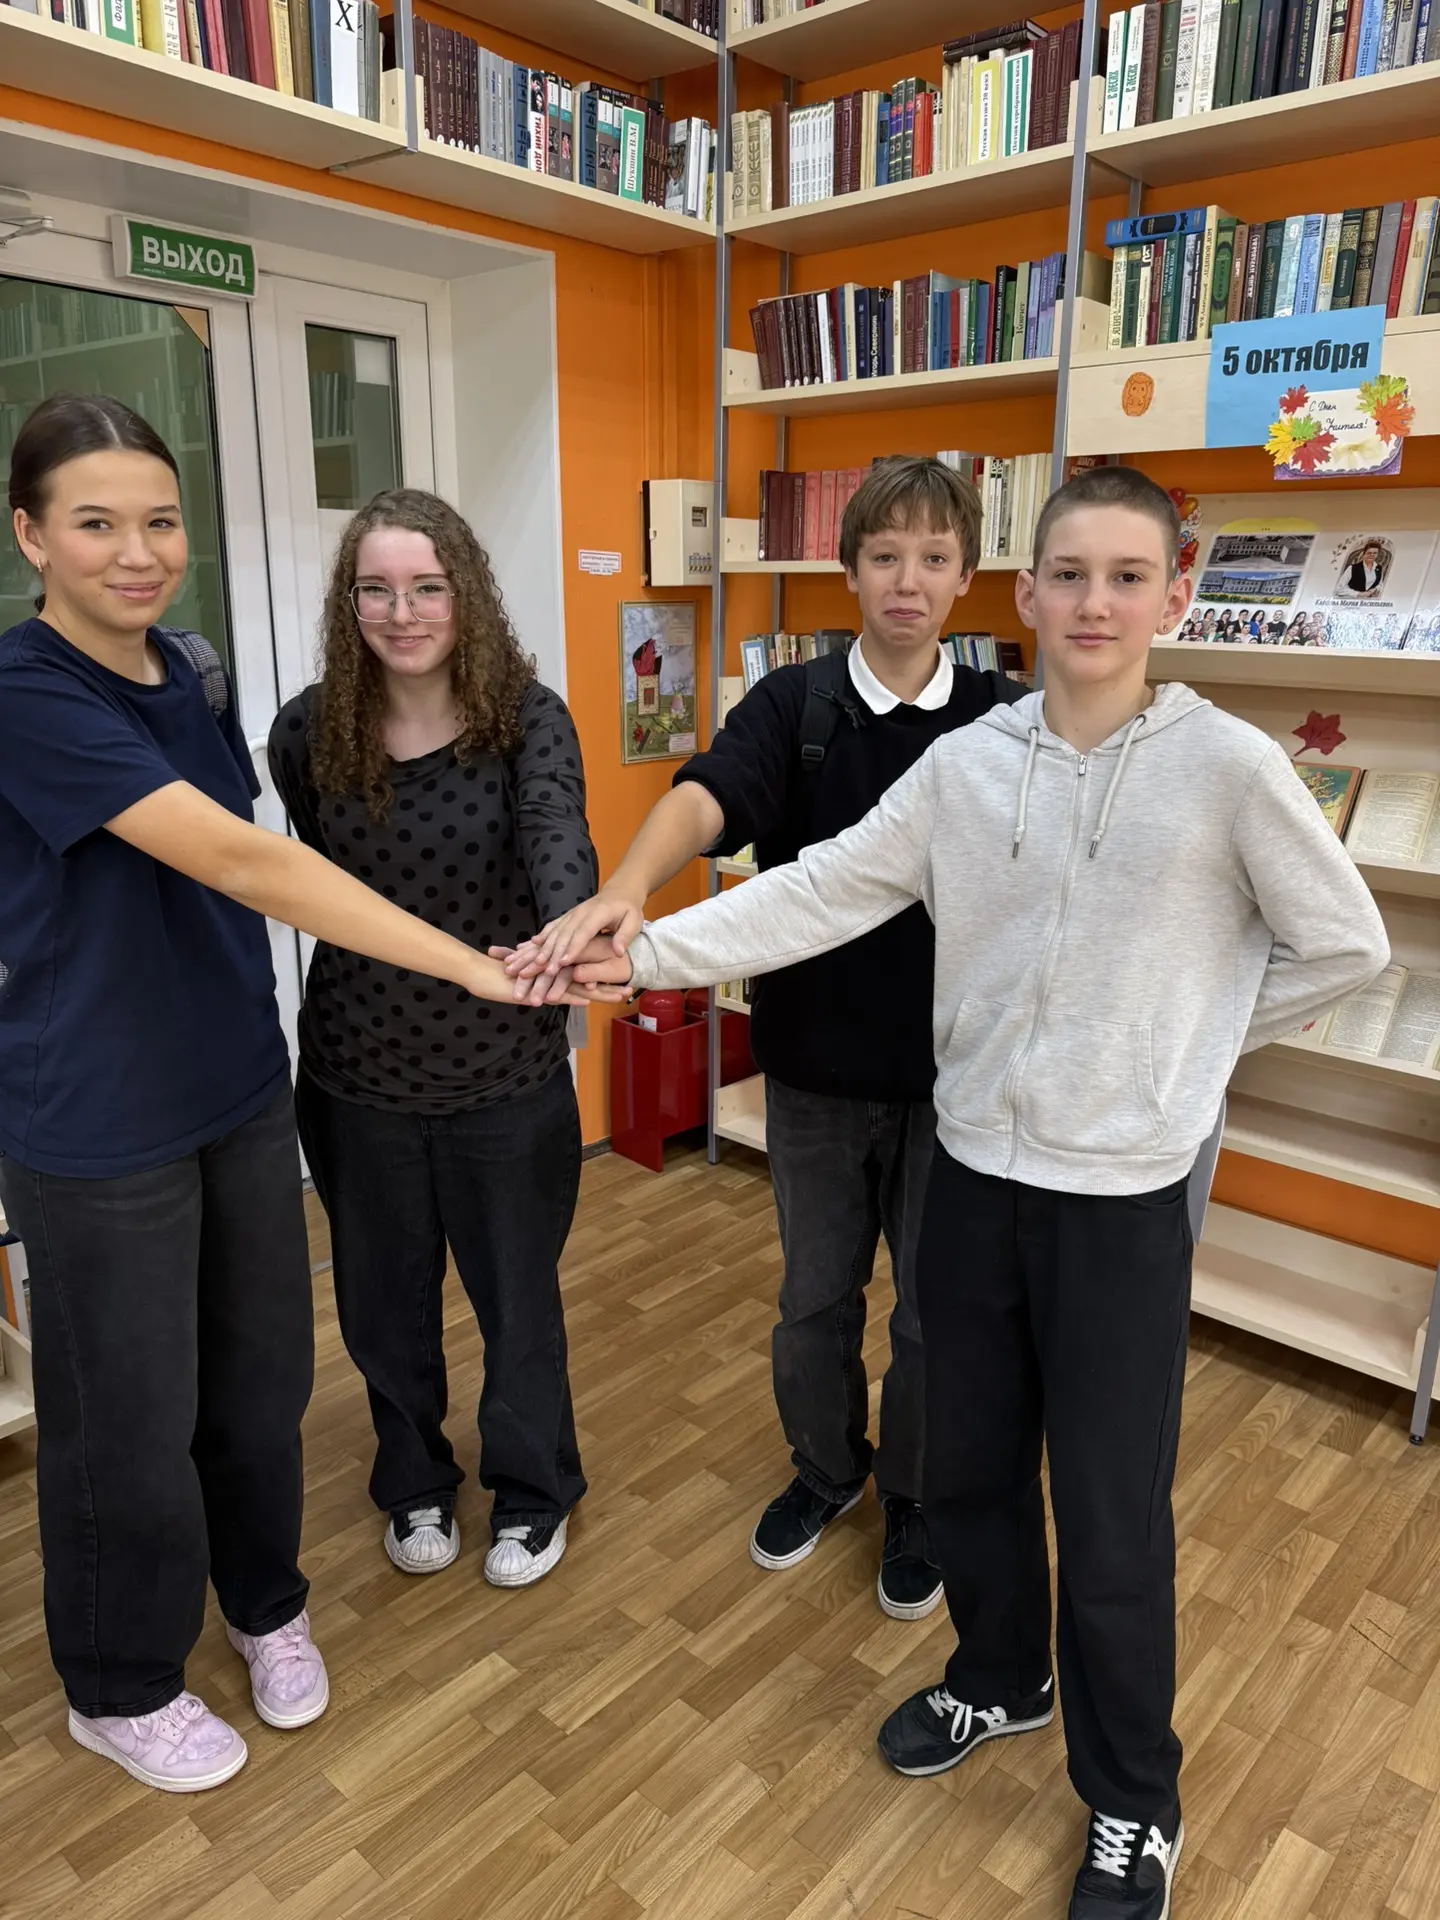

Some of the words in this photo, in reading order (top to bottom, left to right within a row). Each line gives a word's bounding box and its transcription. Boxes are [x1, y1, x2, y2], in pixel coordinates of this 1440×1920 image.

[142, 235, 246, 287] ВЫХОД
[1016, 302, 1025, 334] Ковчег
[1222, 346, 1240, 377] 5
[1245, 339, 1370, 375] октября
